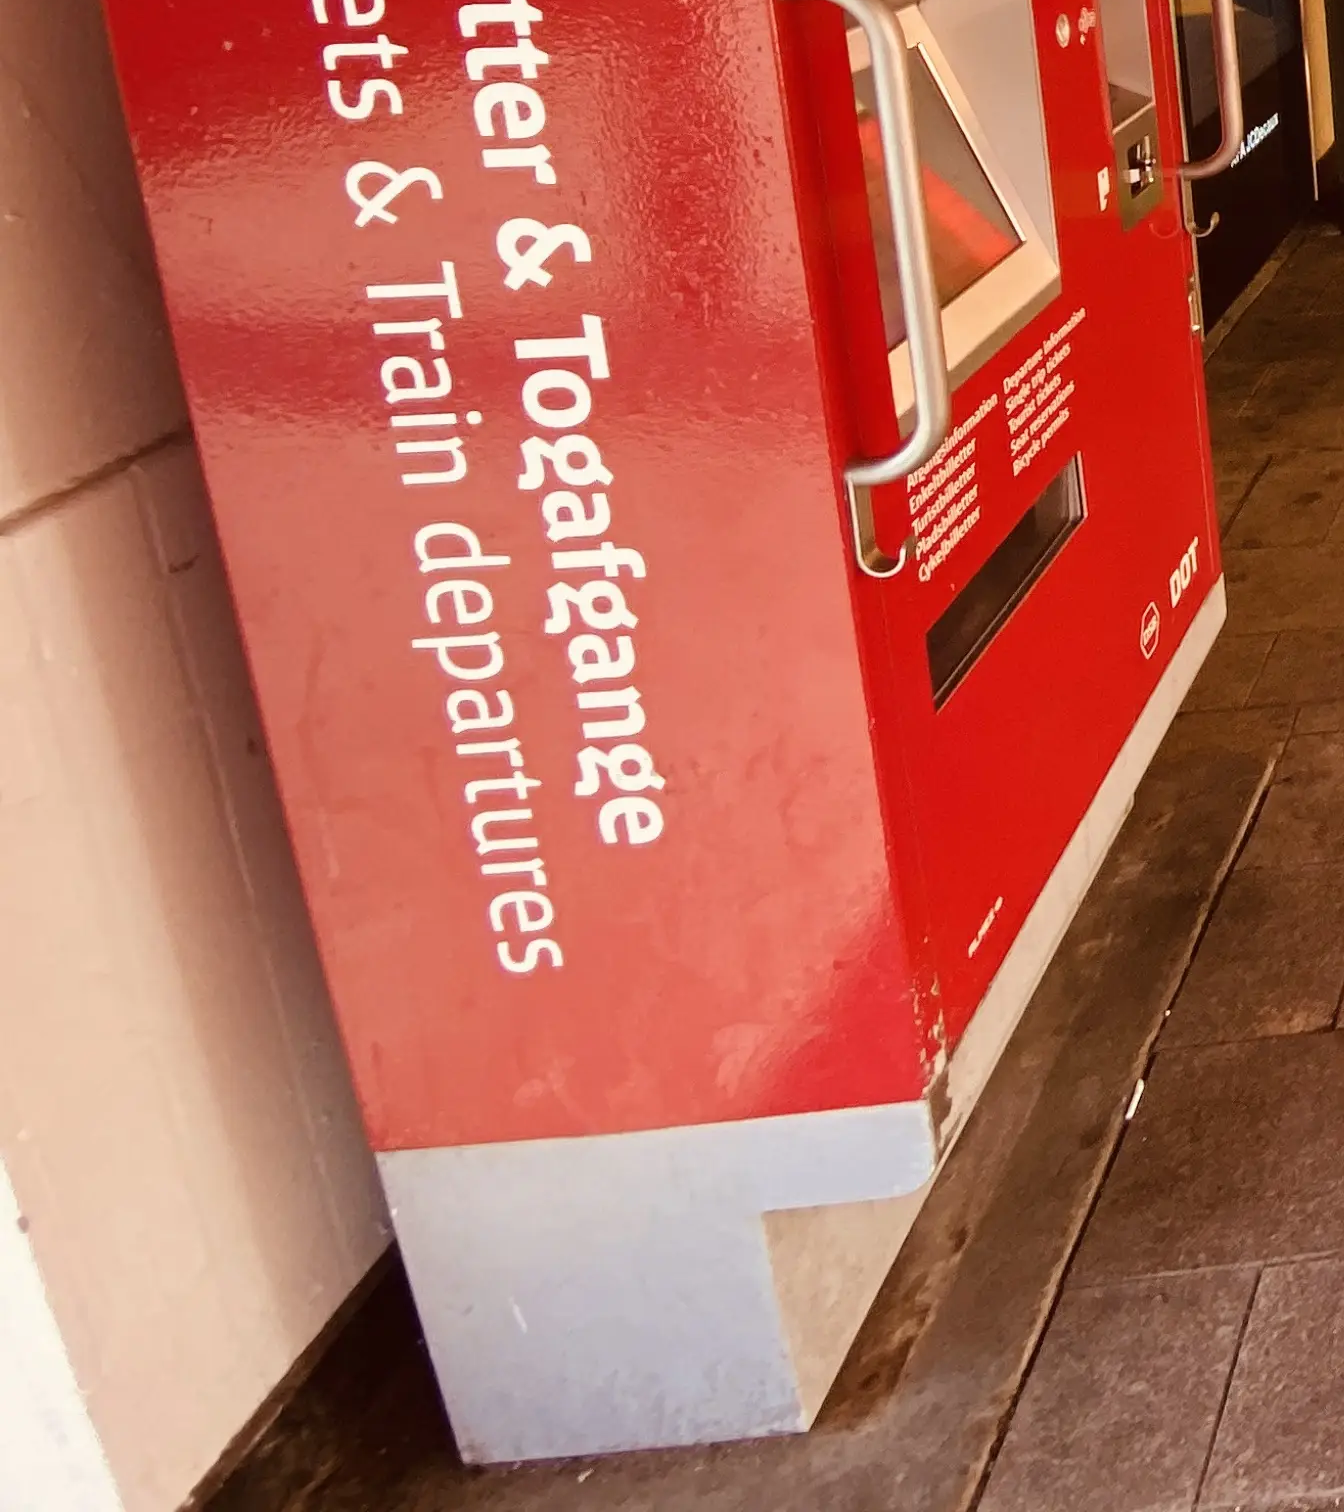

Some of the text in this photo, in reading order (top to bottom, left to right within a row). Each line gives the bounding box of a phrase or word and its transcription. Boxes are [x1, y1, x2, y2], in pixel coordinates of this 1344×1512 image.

[344, 160, 444, 228] &
[495, 217, 592, 291] &
[364, 260, 483, 486] Train
[1003, 348, 1044, 394] Departure
[1005, 342, 1072, 416] Single trip tickets
[1008, 373, 1062, 435] Tourist tickets
[1010, 380, 1075, 457] Seat reservations
[1013, 407, 1070, 478] Bicycle permits
[909, 437, 976, 516] Enkeltbilletter
[911, 462, 976, 536] Turistbilletter
[915, 483, 978, 561] Pladsbilletter
[918, 505, 981, 583] Cykelbilletter
[514, 313, 667, 846] Togafgange
[1169, 536, 1199, 609] DOT
[411, 519, 564, 975] departures
